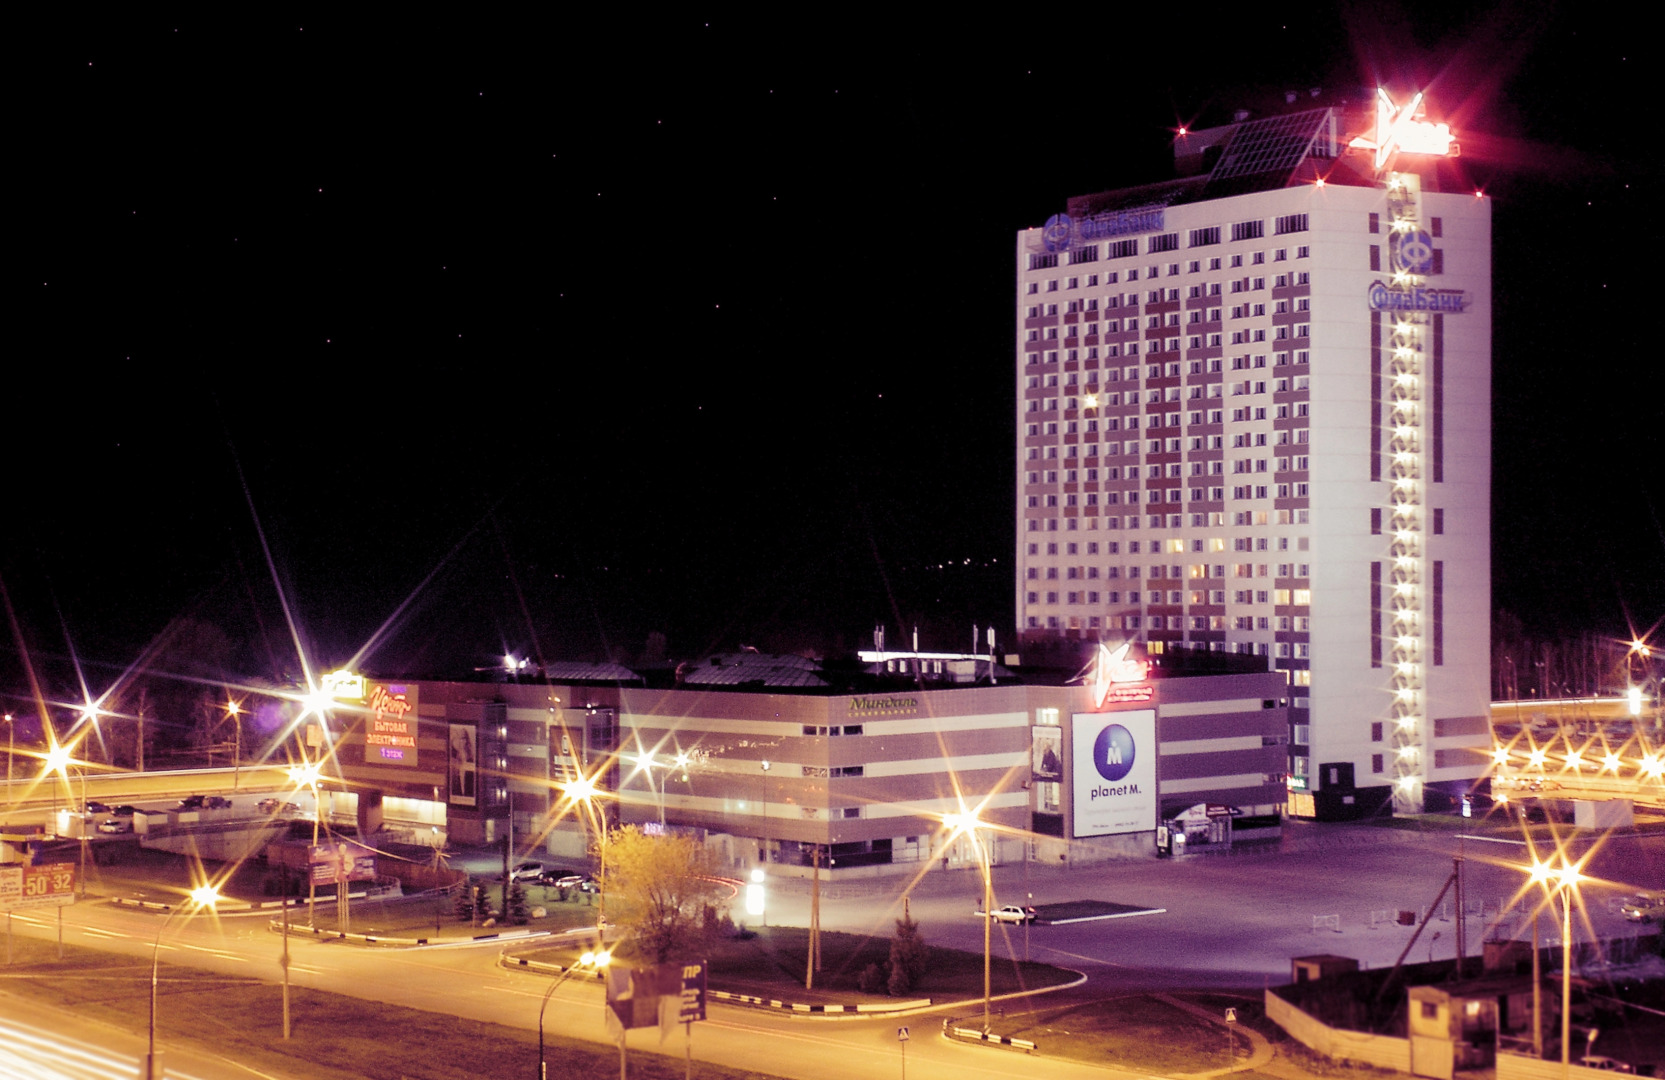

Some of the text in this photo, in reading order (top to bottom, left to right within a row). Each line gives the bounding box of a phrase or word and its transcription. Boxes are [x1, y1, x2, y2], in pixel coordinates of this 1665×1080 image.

[1371, 285, 1464, 311] ФиаБанк
[849, 697, 918, 711] Миндаль
[374, 720, 408, 733] БЫТОВАЯ
[366, 733, 416, 747] ЭЛЕКТРОНИКА
[1091, 785, 1127, 801] planet
